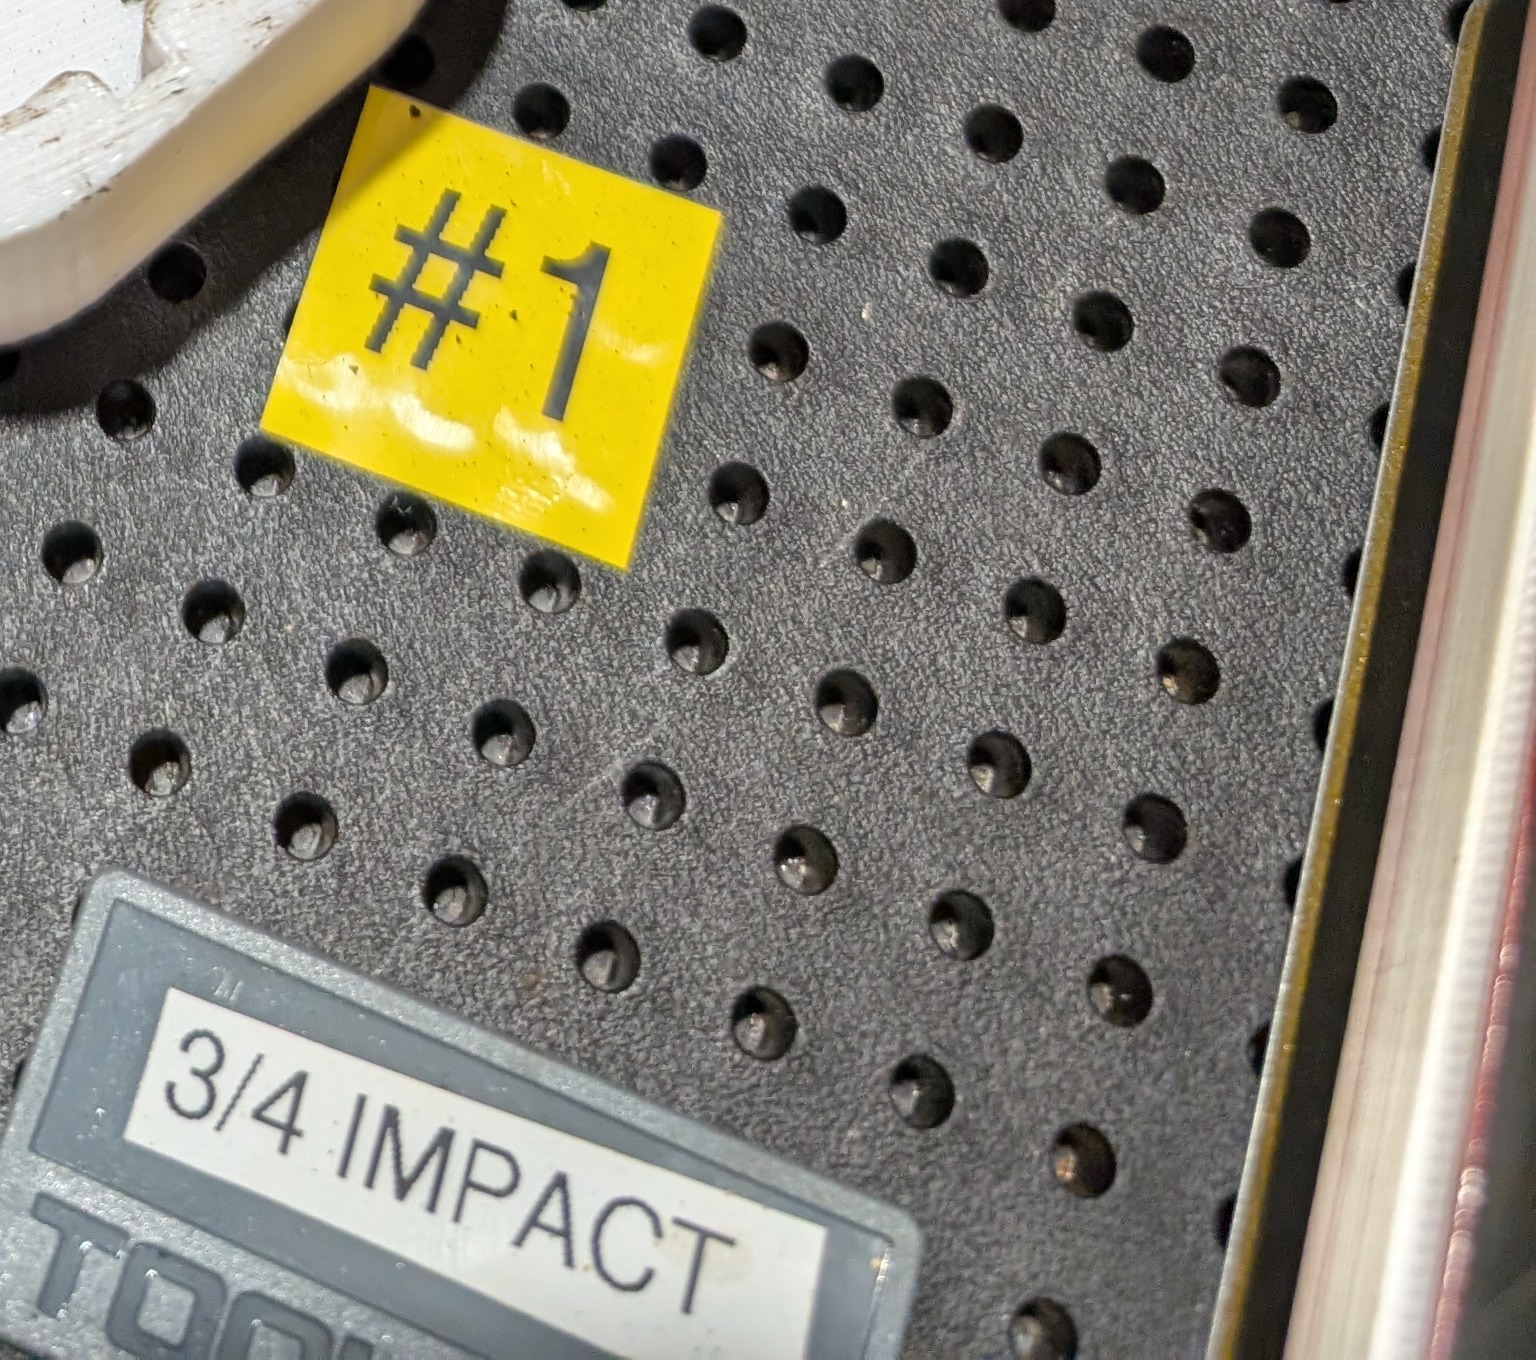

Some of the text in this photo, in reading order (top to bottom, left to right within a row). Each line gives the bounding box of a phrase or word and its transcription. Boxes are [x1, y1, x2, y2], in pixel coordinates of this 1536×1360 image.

[363, 188, 612, 422] #1
[163, 1027, 737, 1316] 3/4 IMPACT
